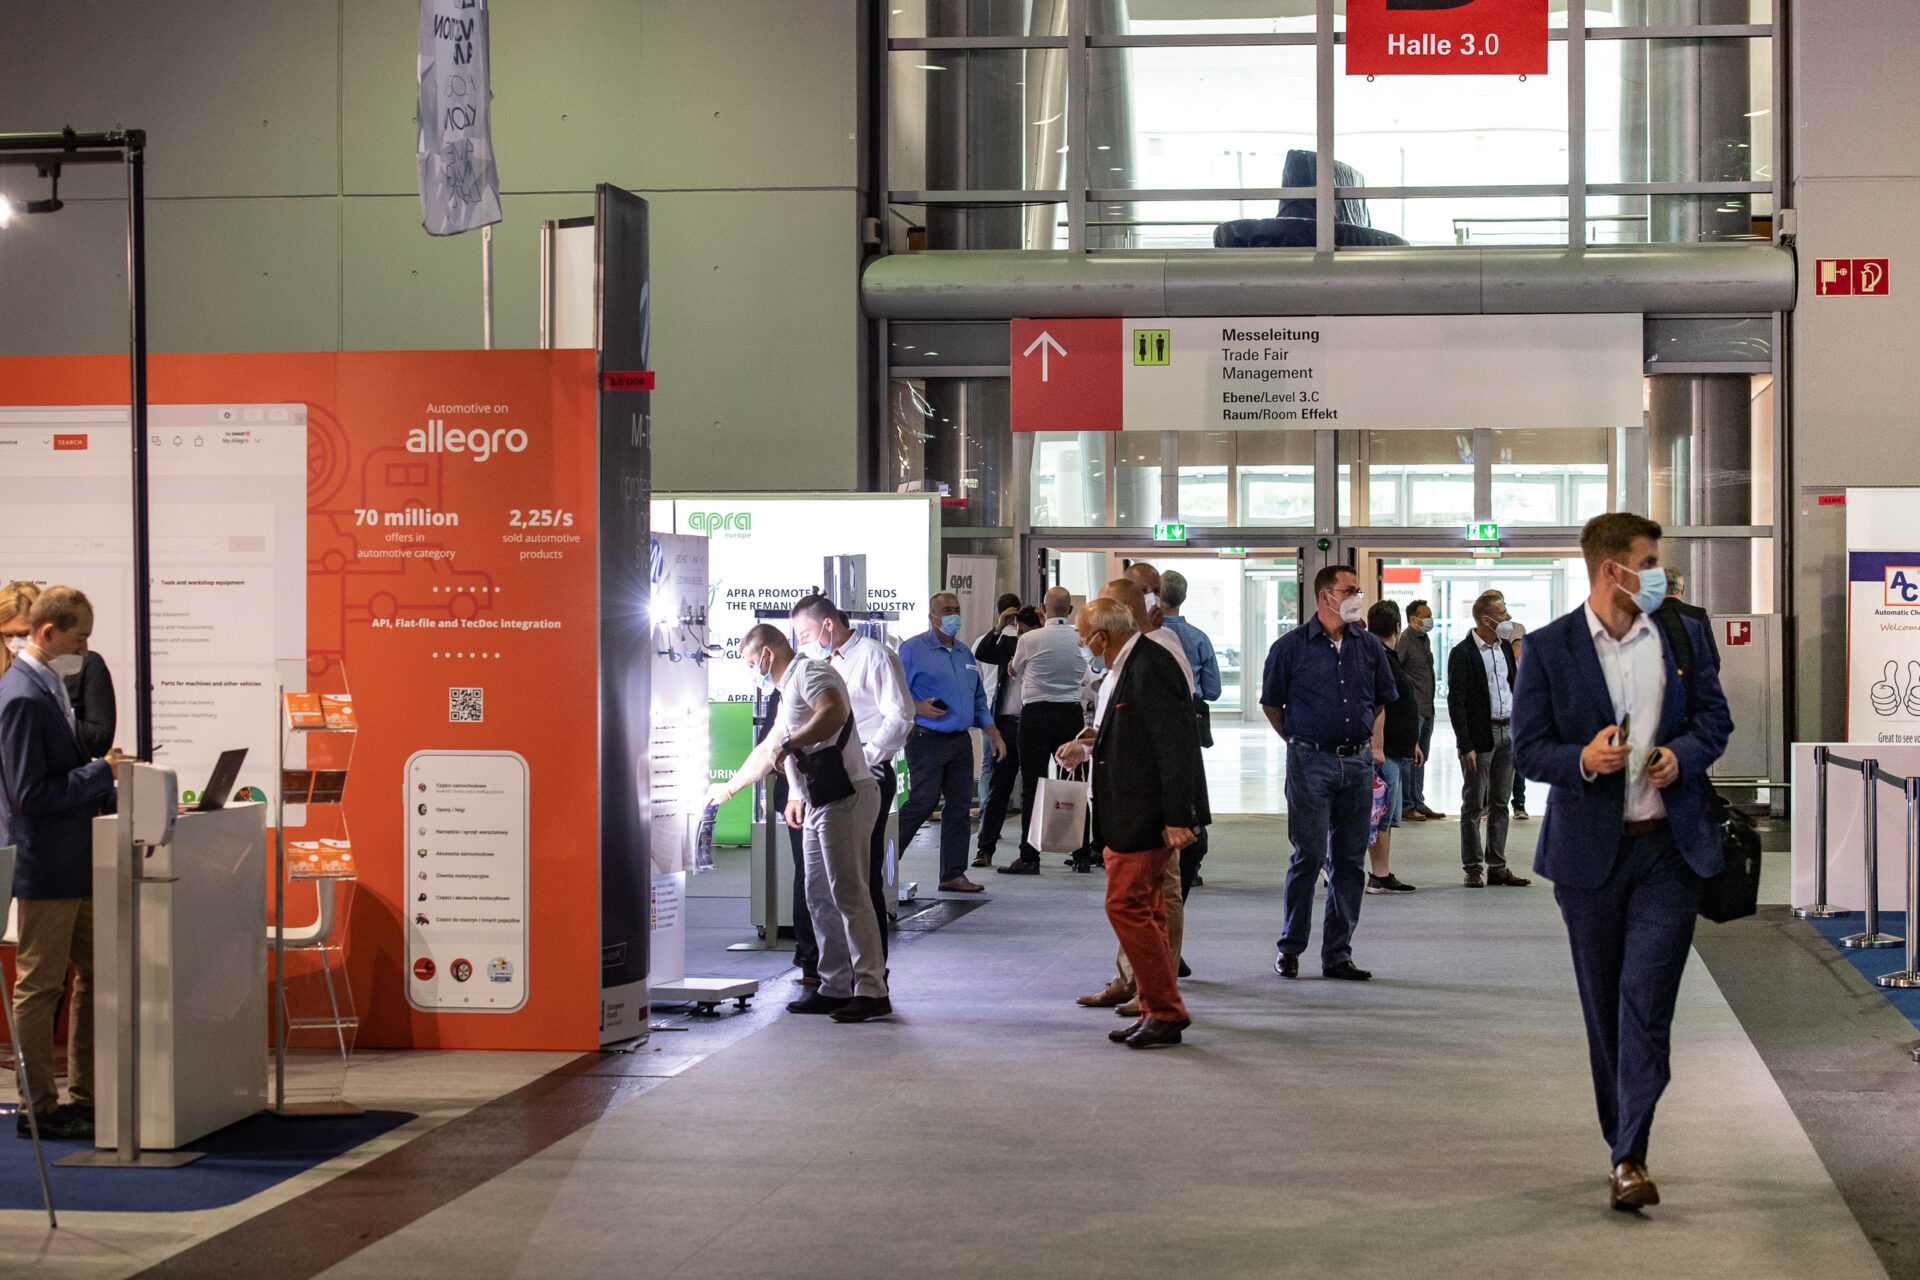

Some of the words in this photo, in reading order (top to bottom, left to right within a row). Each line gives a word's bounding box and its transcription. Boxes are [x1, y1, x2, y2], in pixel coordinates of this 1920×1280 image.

[1388, 33, 1452, 56] Halle
[1460, 33, 1499, 56] 3.0
[1222, 328, 1320, 343] Messeleitung
[1222, 348, 1259, 361] Trade
[1264, 348, 1289, 361] Fair
[1222, 366, 1313, 382] Management
[1222, 391, 1295, 403] Ebene/Level
[1299, 391, 1320, 403] 3.C
[426, 404, 491, 414] Automotive
[494, 405, 509, 414] on
[1223, 408, 1297, 420] Raum/Room
[1301, 408, 1338, 420] Effekt
[406, 420, 529, 462] allegro
[354, 509, 379, 526] 70
[384, 508, 459, 526] million
[509, 509, 574, 529] 2,25/s
[688, 512, 752, 539] apra
[385, 532, 413, 542] offers
[415, 533, 425, 542] in
[502, 533, 523, 543] sold
[525, 533, 581, 543] automotive
[357, 549, 412, 558] automotive
[414, 549, 456, 560] category
[519, 550, 563, 561] products
[188, 579, 214, 587] workshop
[726, 588, 756, 598] APRA
[758, 588, 812, 598] PROMOTE
[868, 589, 897, 598] ENDS
[726, 602, 747, 611] THE
[867, 602, 915, 611] NDUSTRY
[372, 618, 393, 629] API,
[395, 618, 436, 629] Flat-file
[438, 618, 458, 628] and
[460, 618, 498, 629] TecDoc
[500, 618, 562, 631] integration
[1878, 732, 1894, 743] Great
[1895, 734, 1903, 743] to
[1903, 734, 1914, 743] see
